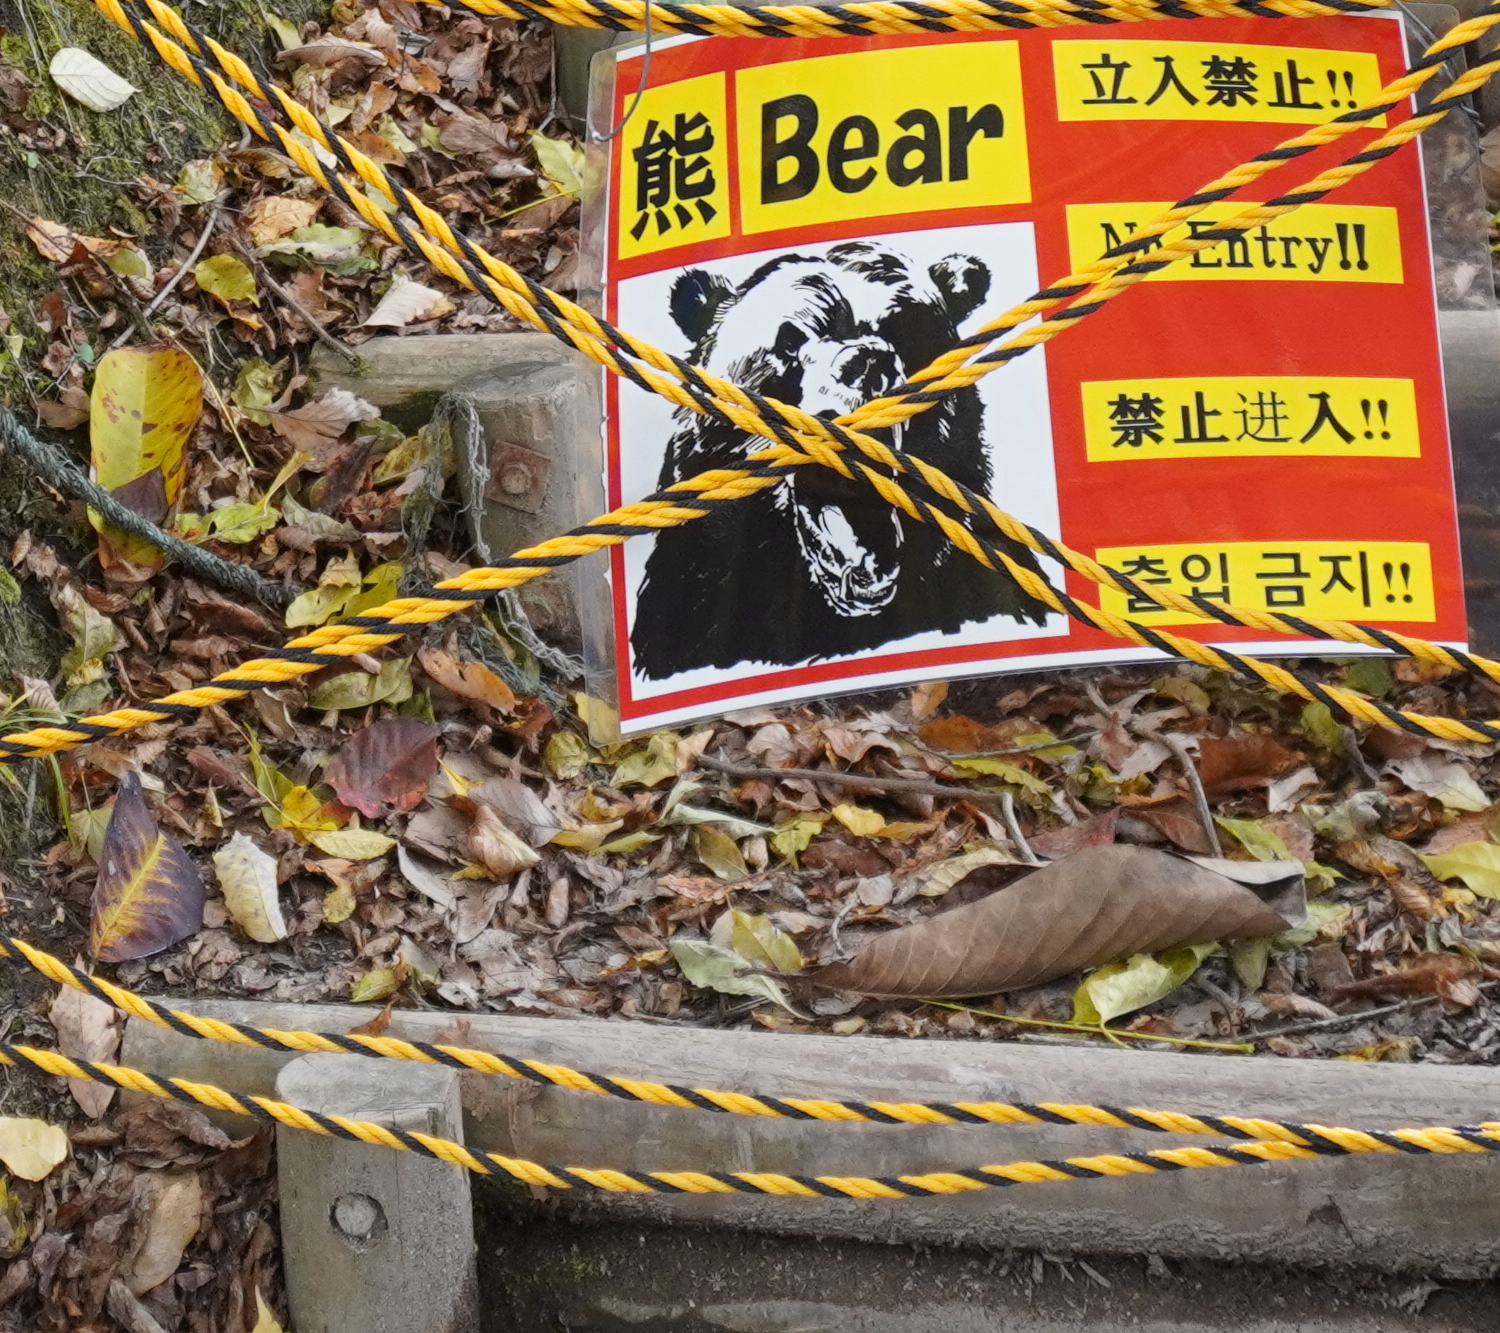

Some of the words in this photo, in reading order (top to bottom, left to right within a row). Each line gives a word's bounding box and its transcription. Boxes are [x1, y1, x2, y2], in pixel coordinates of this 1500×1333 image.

[1081, 53, 1358, 110] 立入禁止!!
[630, 111, 717, 241] 熊
[761, 94, 1004, 205] Bear
[1187, 221, 1369, 274] Entry!!
[1108, 391, 1391, 448] 禁止进入!!
[1256, 551, 1413, 608] 금지!!
